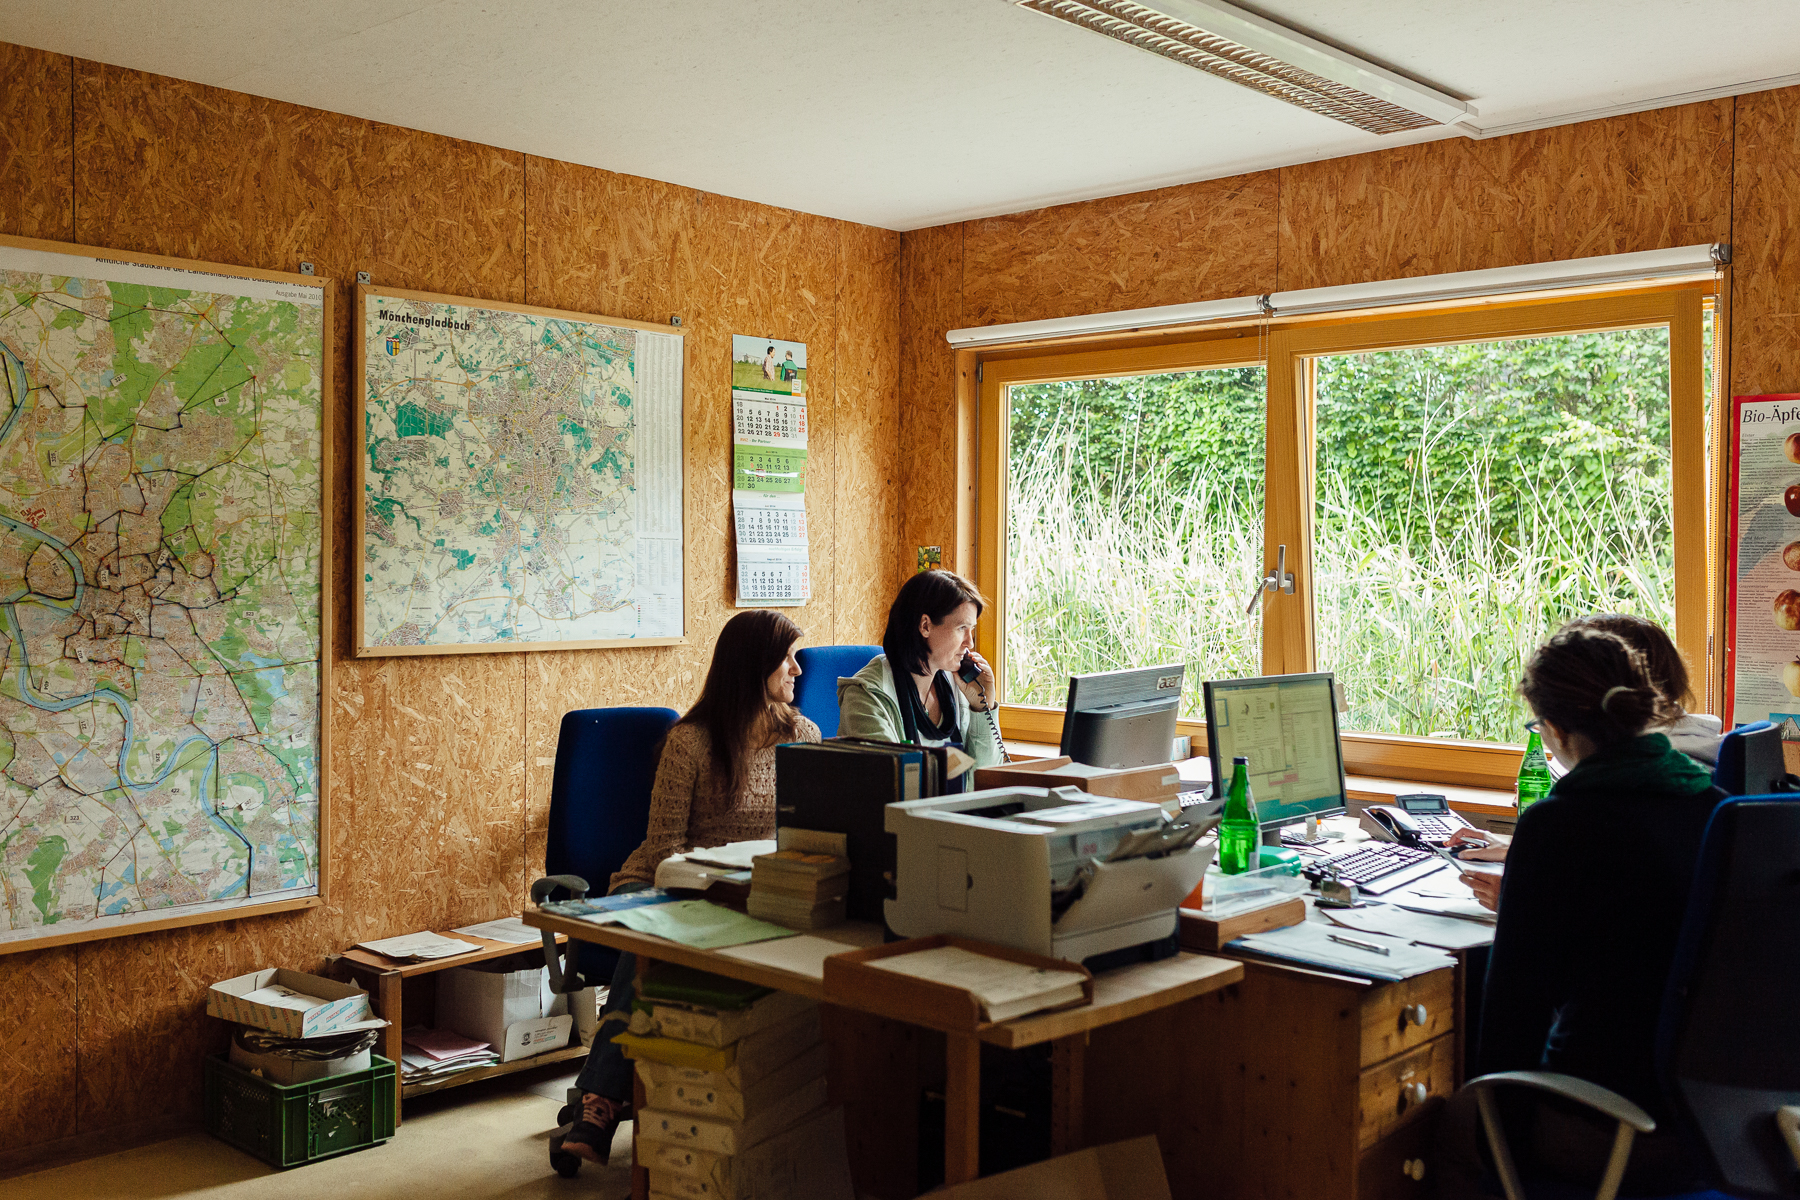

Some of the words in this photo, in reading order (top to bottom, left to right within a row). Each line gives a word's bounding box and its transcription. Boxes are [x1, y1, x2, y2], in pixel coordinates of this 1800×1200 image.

[276, 290, 297, 298] Ausgabe
[379, 310, 470, 331] Mönchengladbach
[1158, 676, 1180, 689] acer
